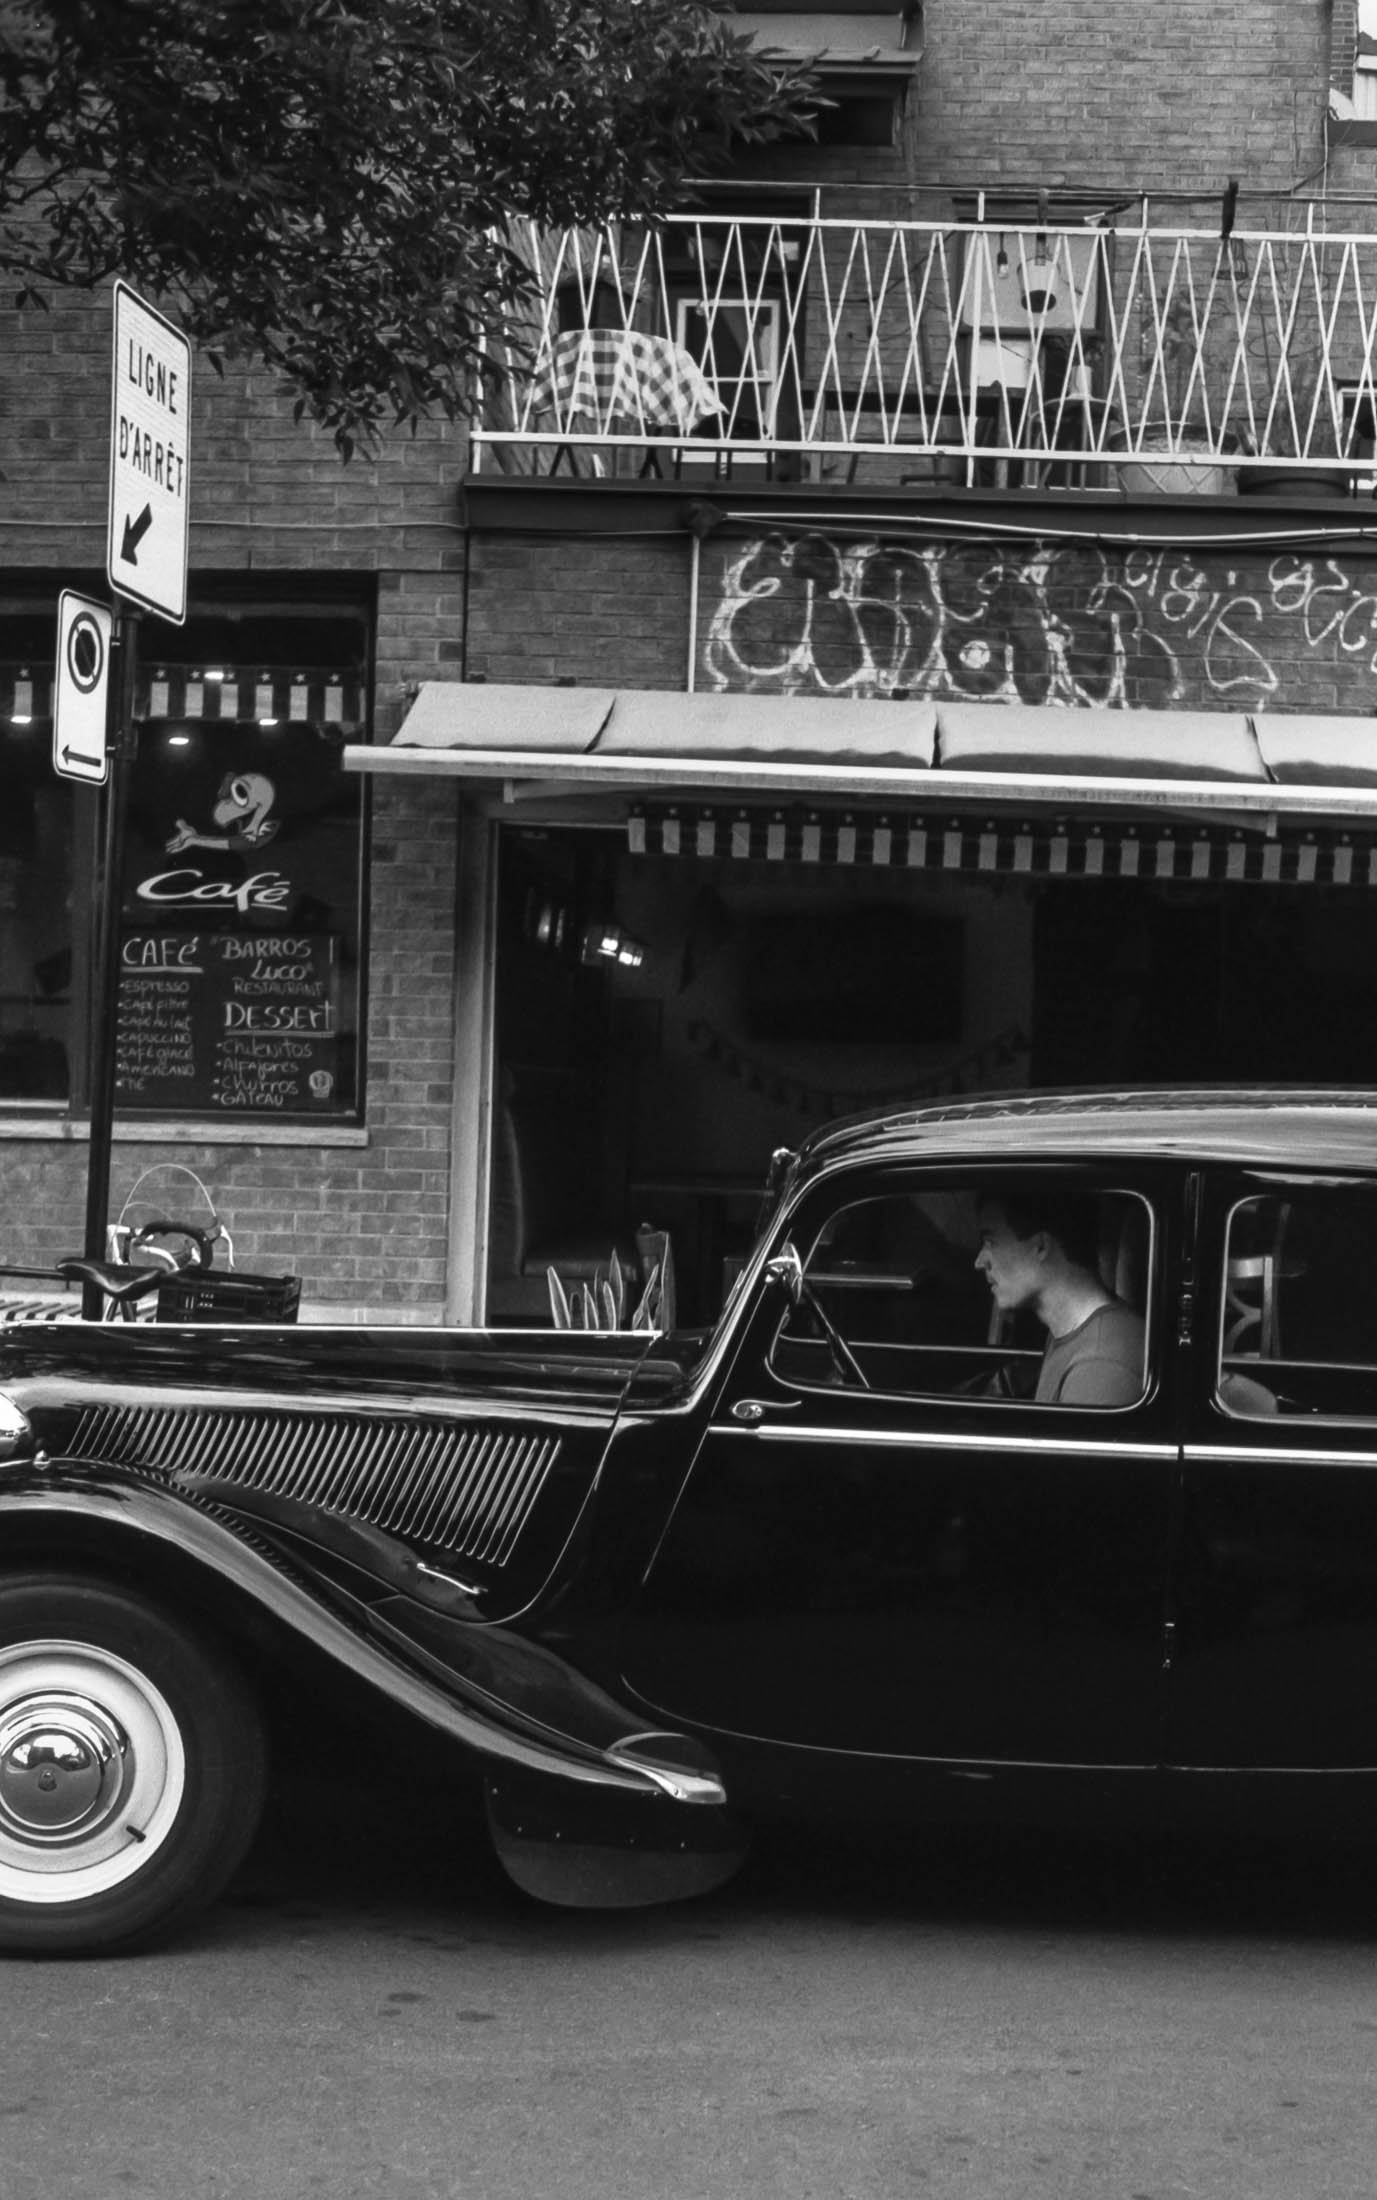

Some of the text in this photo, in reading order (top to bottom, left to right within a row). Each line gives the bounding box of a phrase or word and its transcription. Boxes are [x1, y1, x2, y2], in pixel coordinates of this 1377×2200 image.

[128, 338, 178, 416] LIGNE
[119, 415, 184, 499] D'ARRÊT
[136, 868, 291, 912] Café
[221, 1074, 299, 1095] Churros
